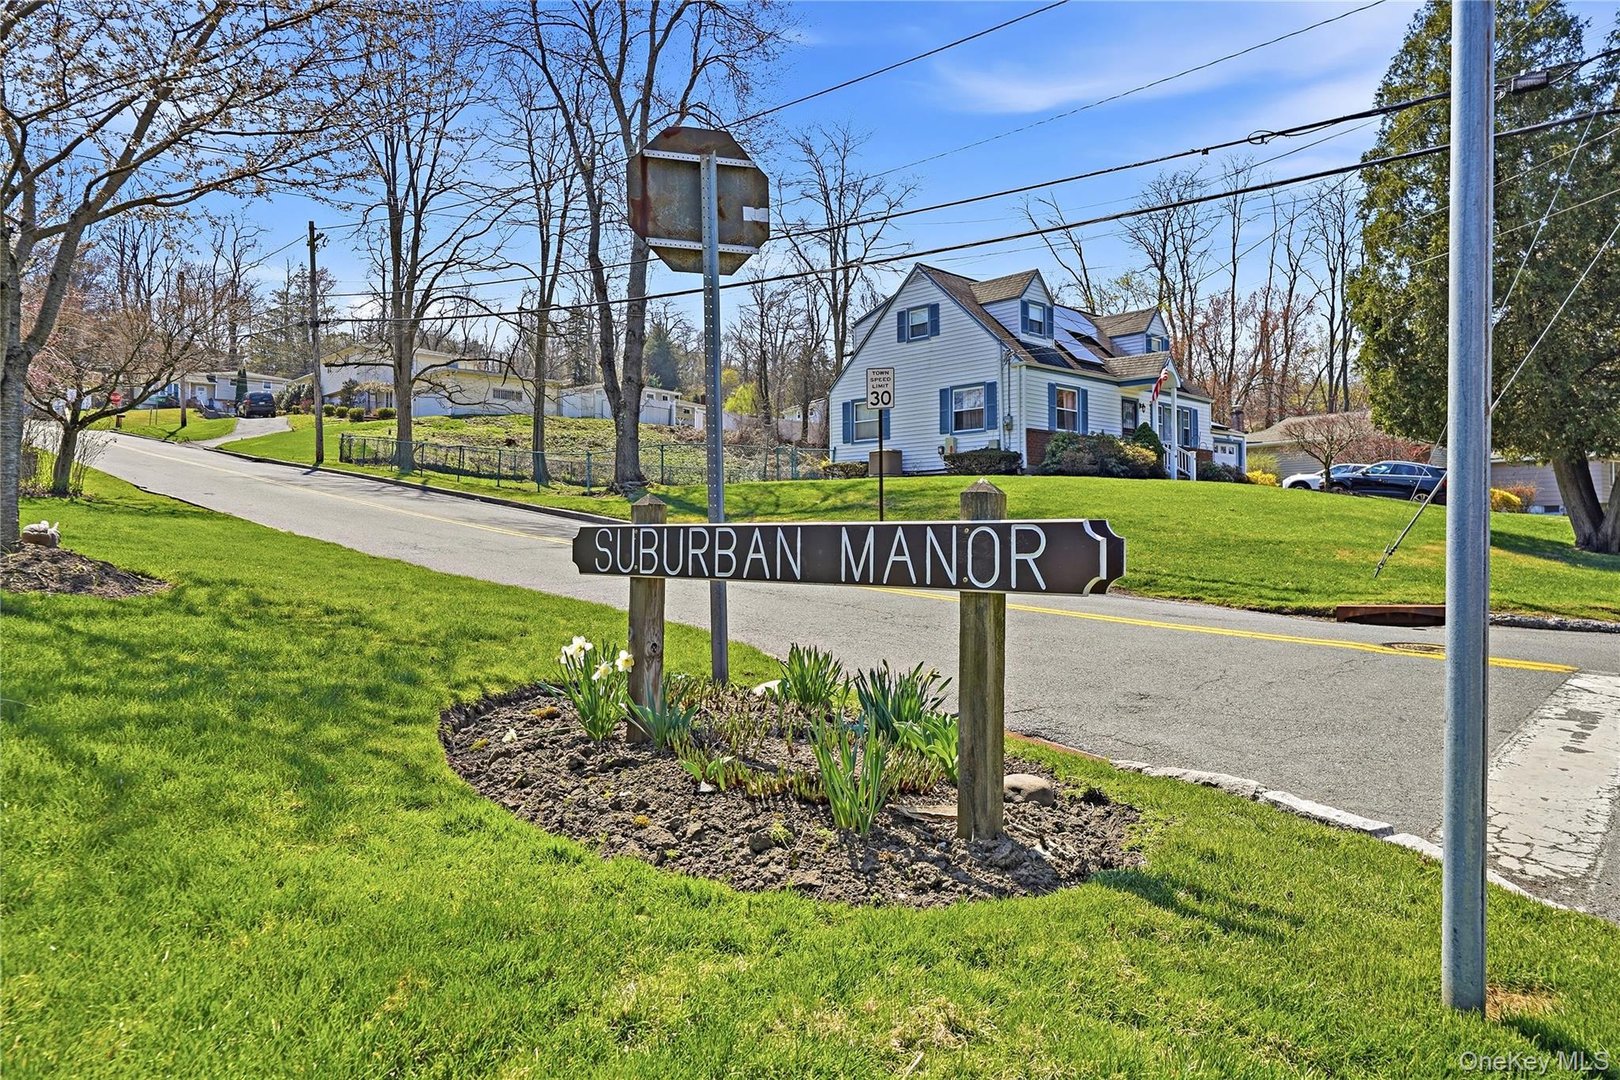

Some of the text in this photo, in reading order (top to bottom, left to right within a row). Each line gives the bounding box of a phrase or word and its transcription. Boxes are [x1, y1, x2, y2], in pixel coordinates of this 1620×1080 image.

[870, 390, 891, 406] 30
[594, 524, 1047, 590] SUBURBAN MANOR
